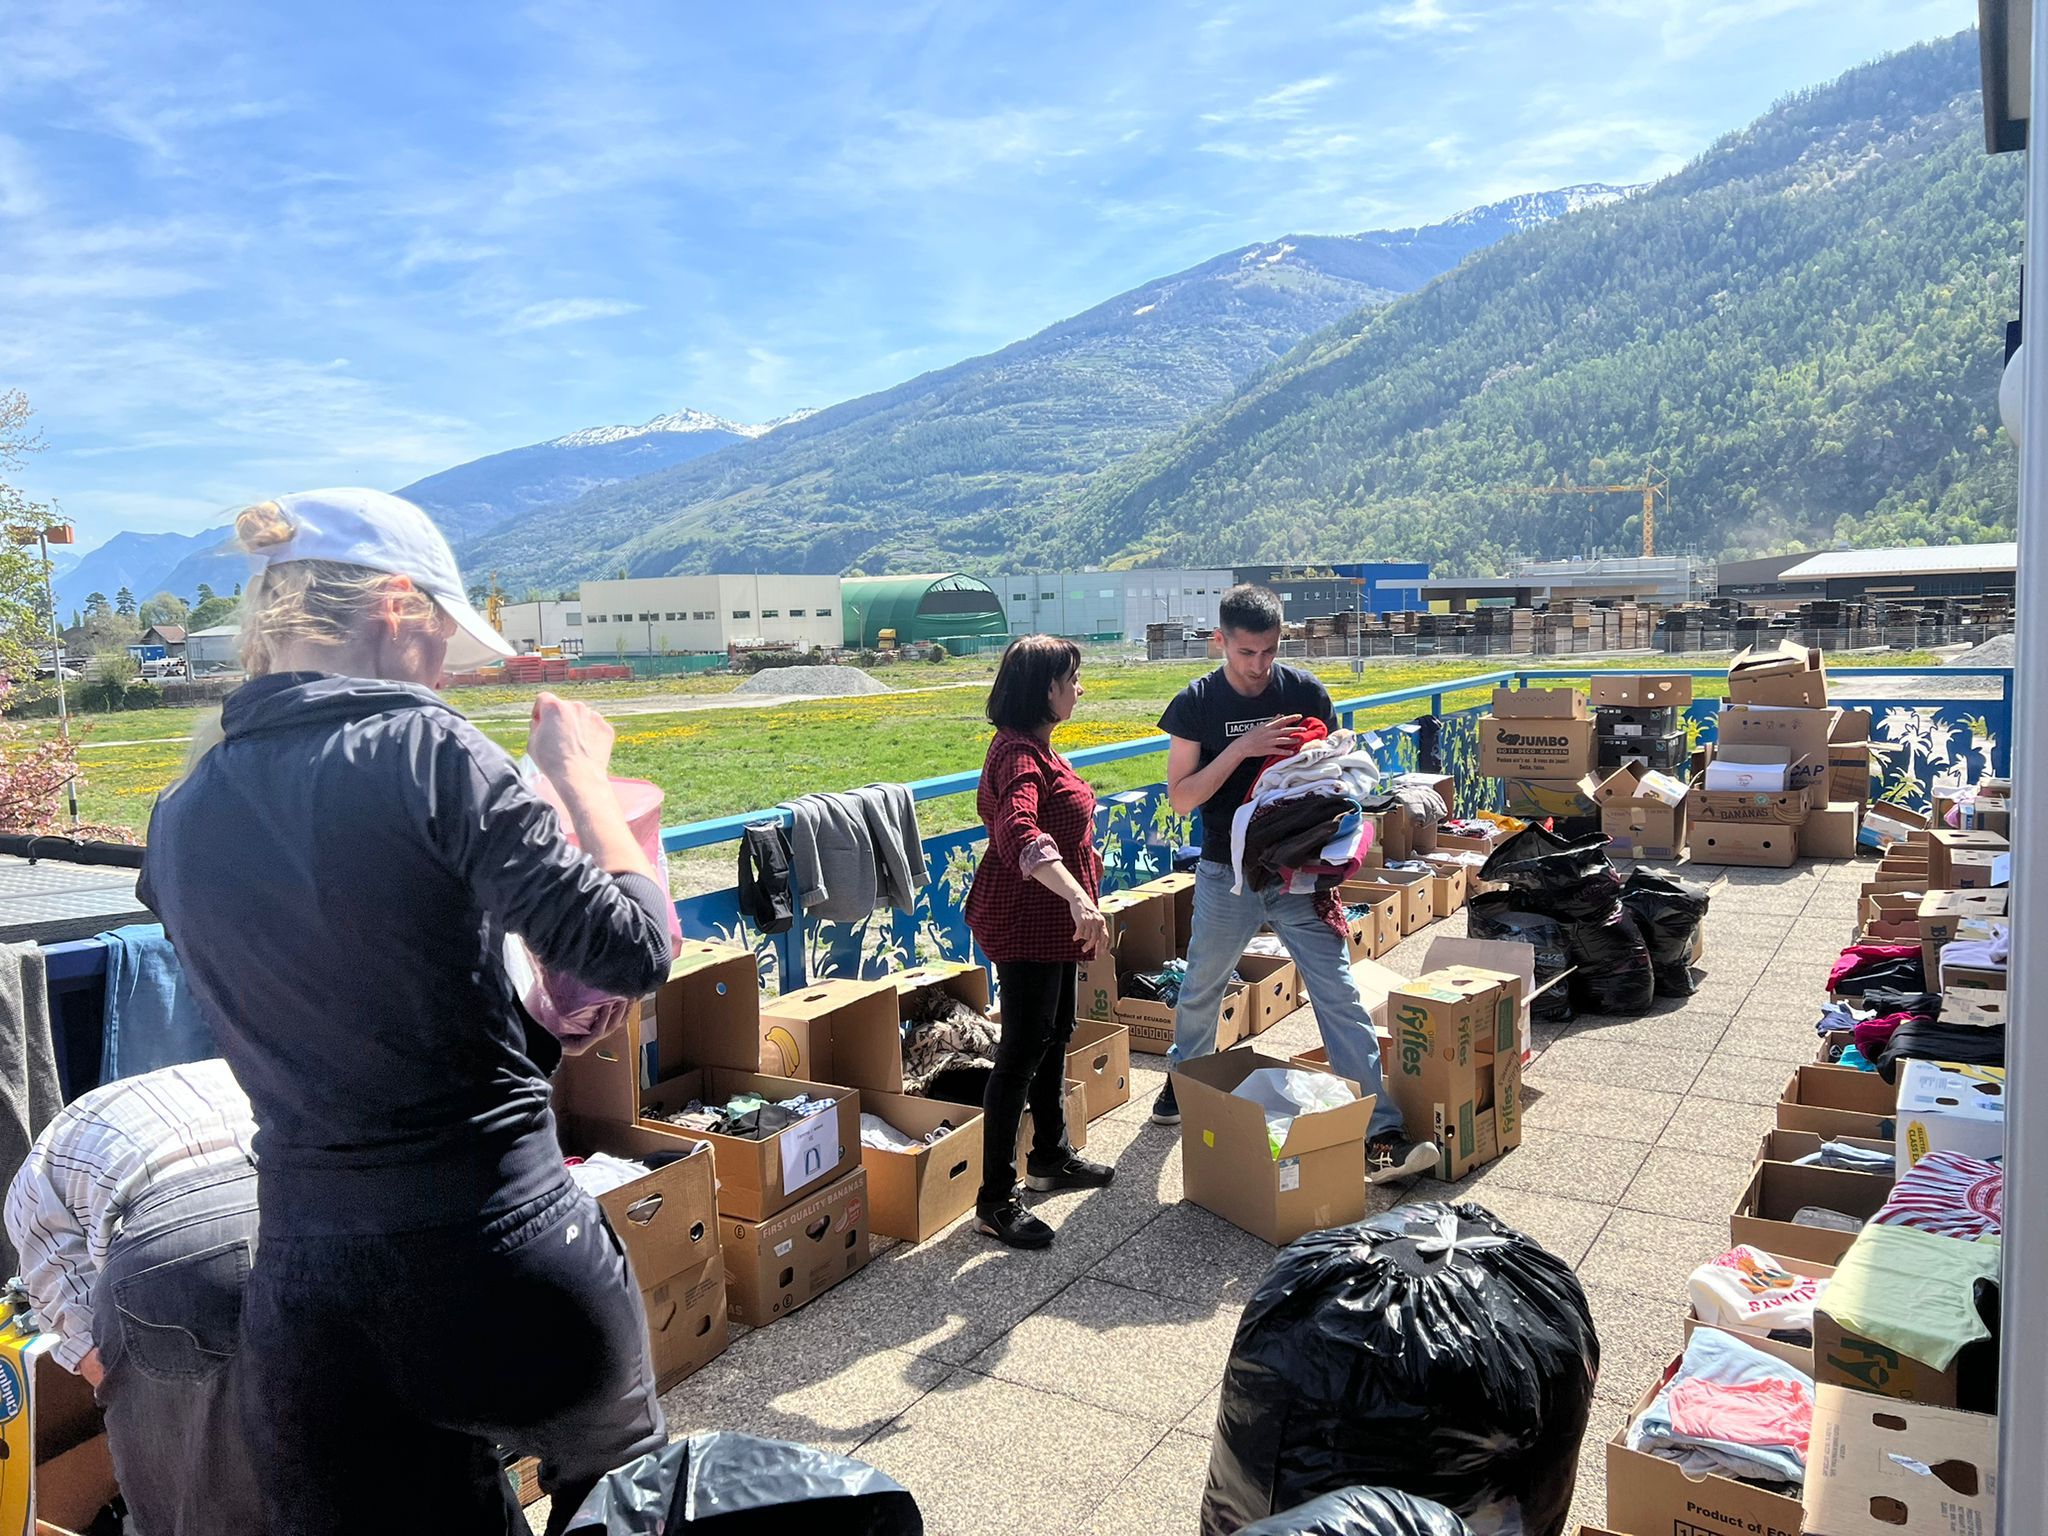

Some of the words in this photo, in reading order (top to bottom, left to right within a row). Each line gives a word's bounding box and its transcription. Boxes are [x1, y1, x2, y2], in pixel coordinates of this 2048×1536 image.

[1519, 736, 1569, 747] JUMBO
[1720, 808, 1769, 820] BANANAS
[1144, 1015, 1171, 1024] ECUADOR
[1908, 1129, 1919, 1152] CLASS
[762, 1219, 788, 1239] FIRST
[790, 1200, 826, 1224] QUALITY
[827, 1178, 864, 1205] BANANAS
[1686, 1501, 1744, 1529] Product
[1747, 1523, 1762, 1534] of
